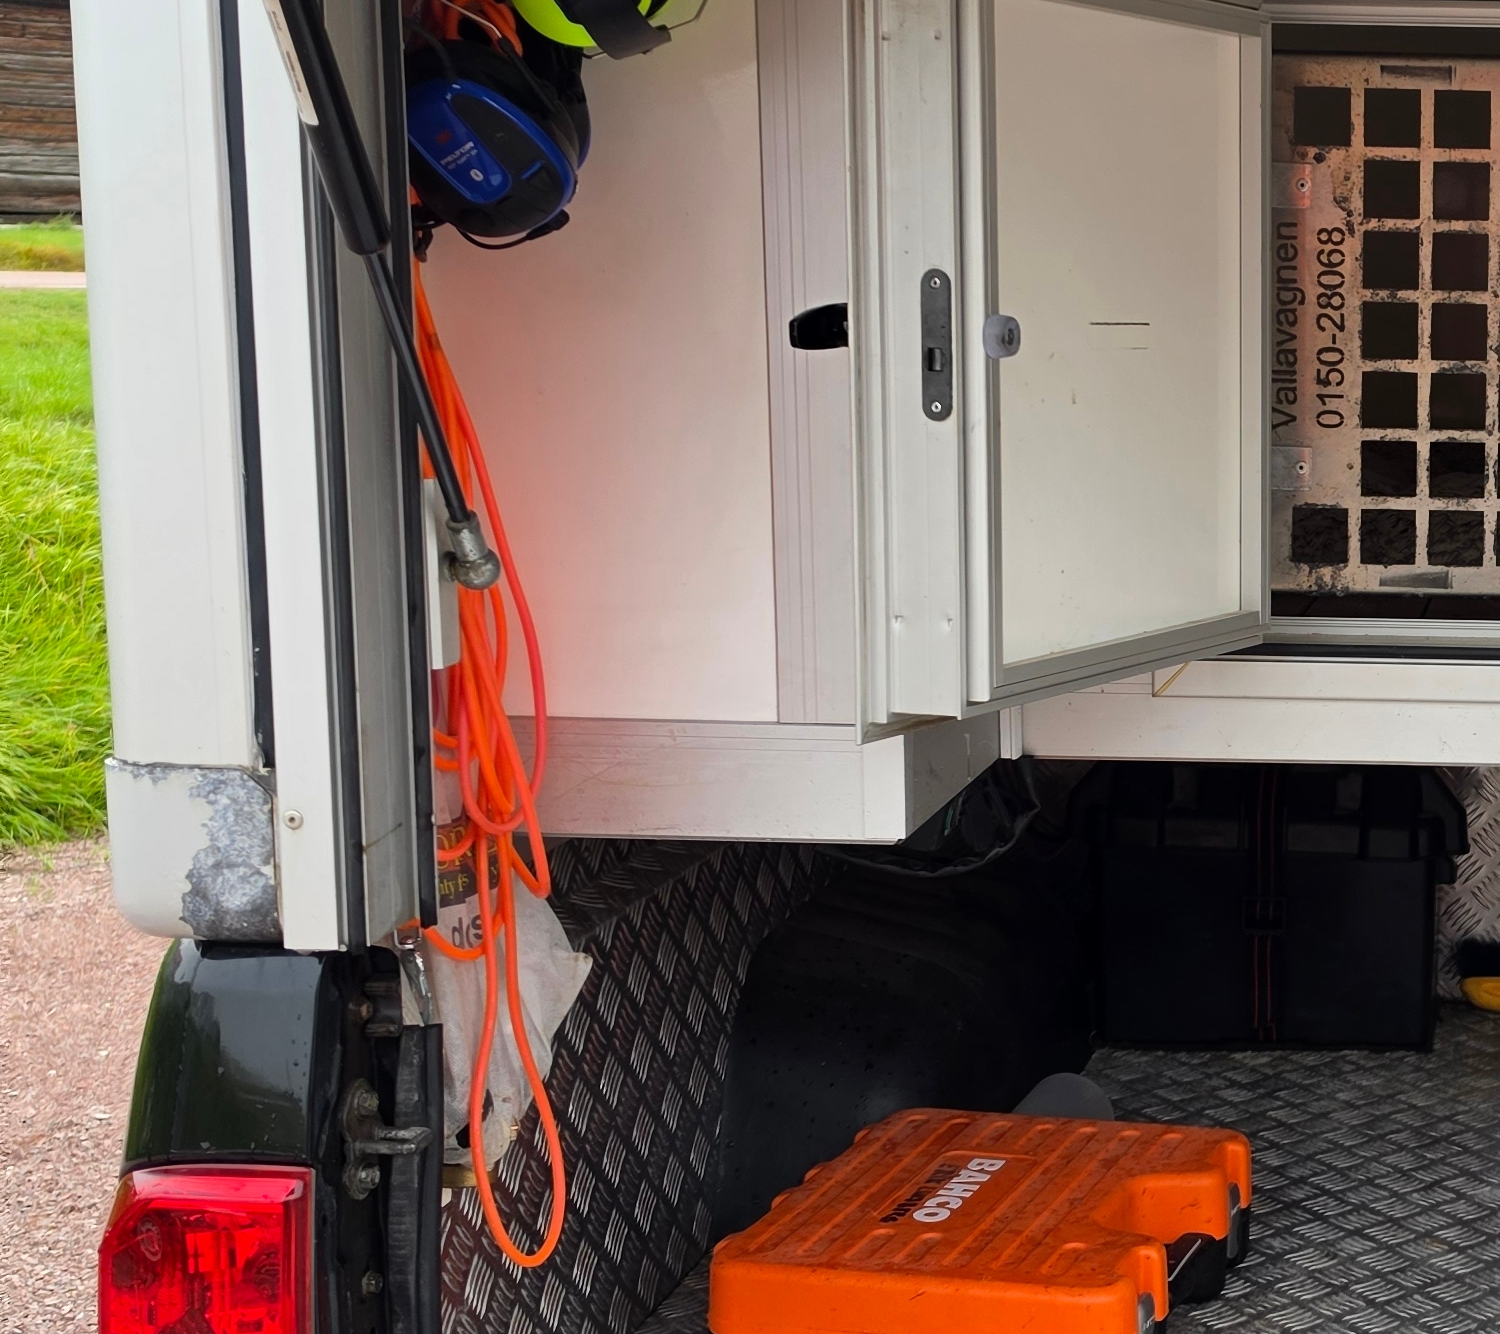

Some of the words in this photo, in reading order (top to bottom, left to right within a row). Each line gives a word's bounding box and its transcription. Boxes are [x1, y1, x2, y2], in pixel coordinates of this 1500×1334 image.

[1271, 221, 1306, 432] Vallavagnen
[1316, 226, 1346, 429] 0150-28068
[912, 1157, 1007, 1223] BAHCO
